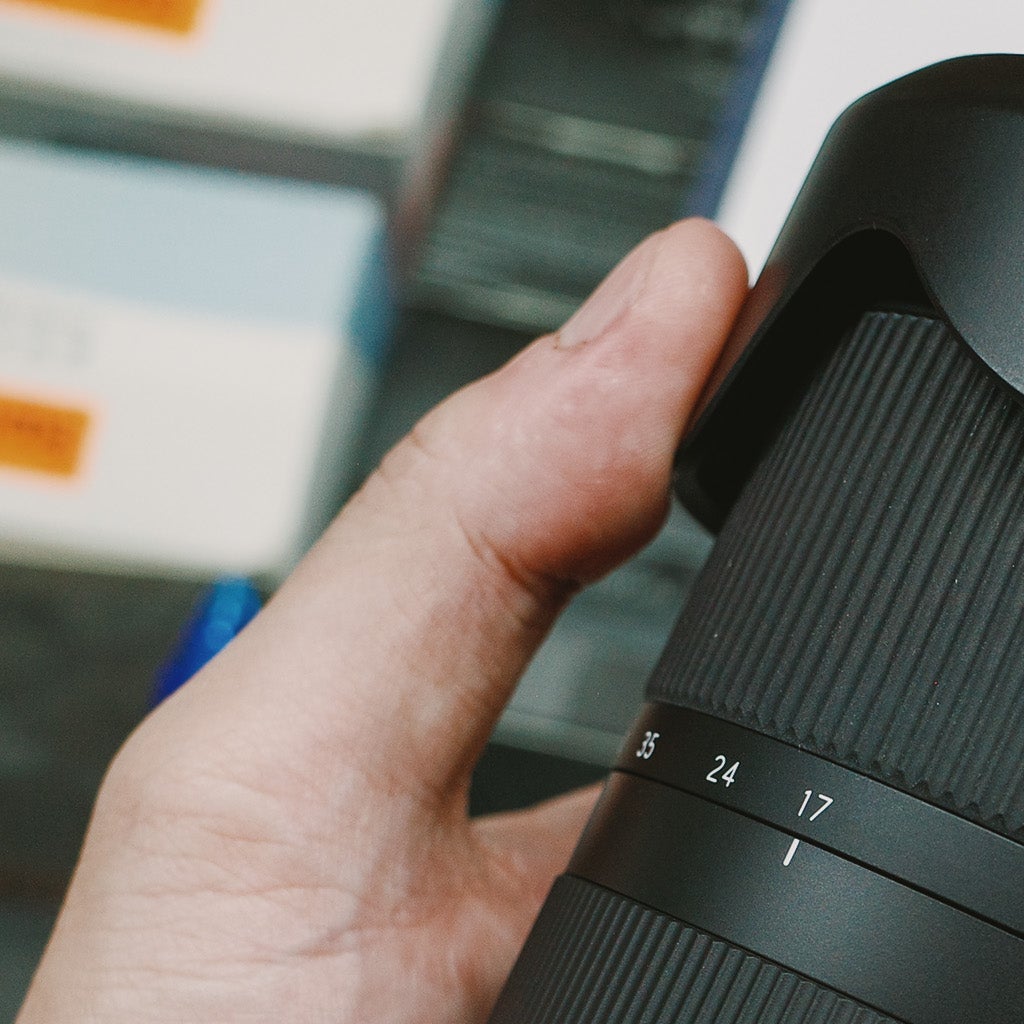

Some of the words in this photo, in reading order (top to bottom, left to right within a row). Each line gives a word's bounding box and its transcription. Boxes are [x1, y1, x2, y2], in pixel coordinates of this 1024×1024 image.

[636, 731, 660, 760] 35
[706, 755, 740, 787] 24
[798, 789, 834, 821] 17
